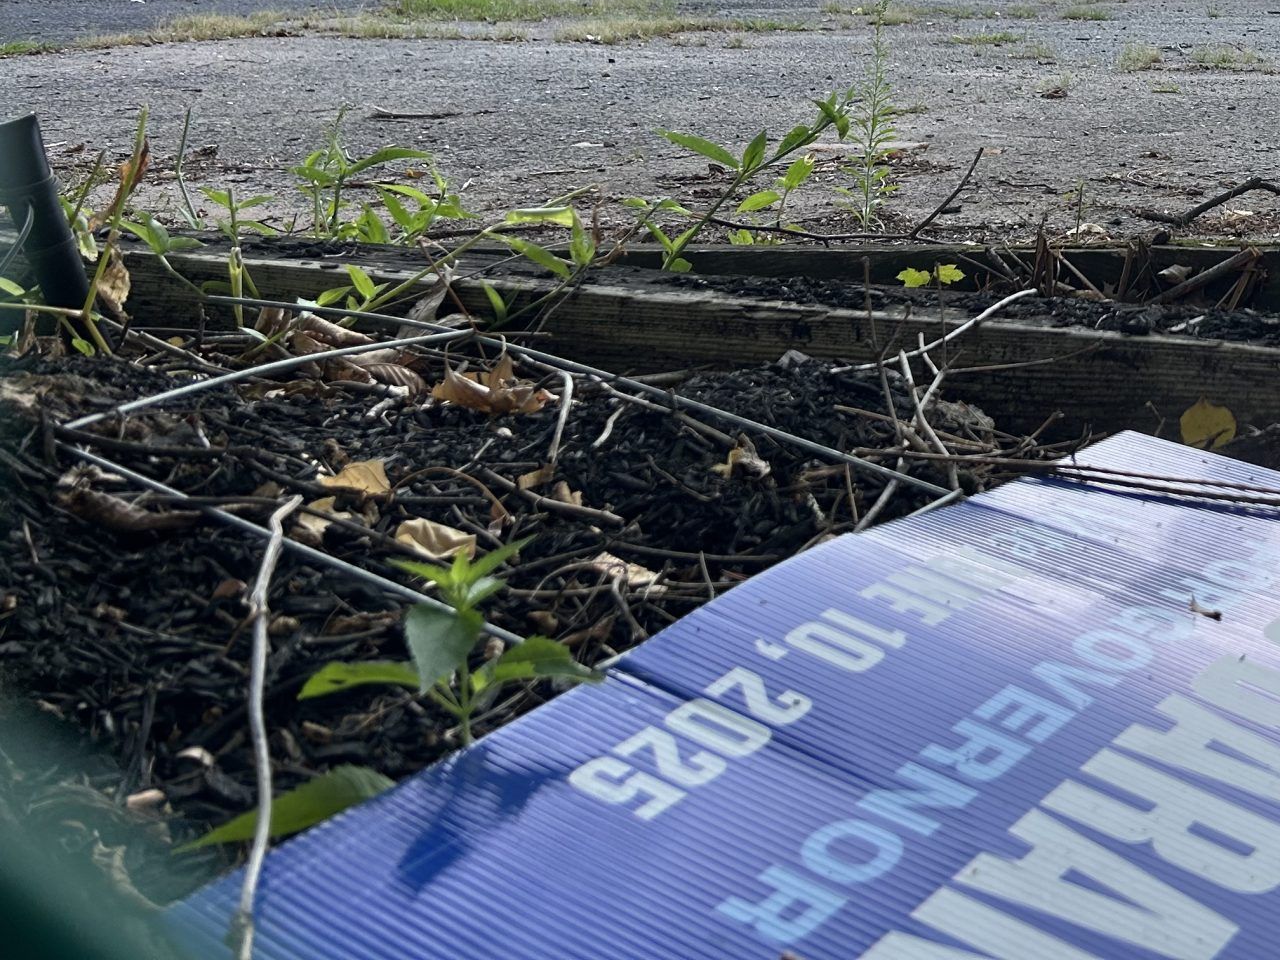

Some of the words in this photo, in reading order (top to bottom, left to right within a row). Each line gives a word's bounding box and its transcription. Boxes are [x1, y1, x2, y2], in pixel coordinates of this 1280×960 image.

[755, 608, 907, 674] 10,
[569, 666, 812, 821] 2025
[714, 604, 1198, 943] GOVERNOR
